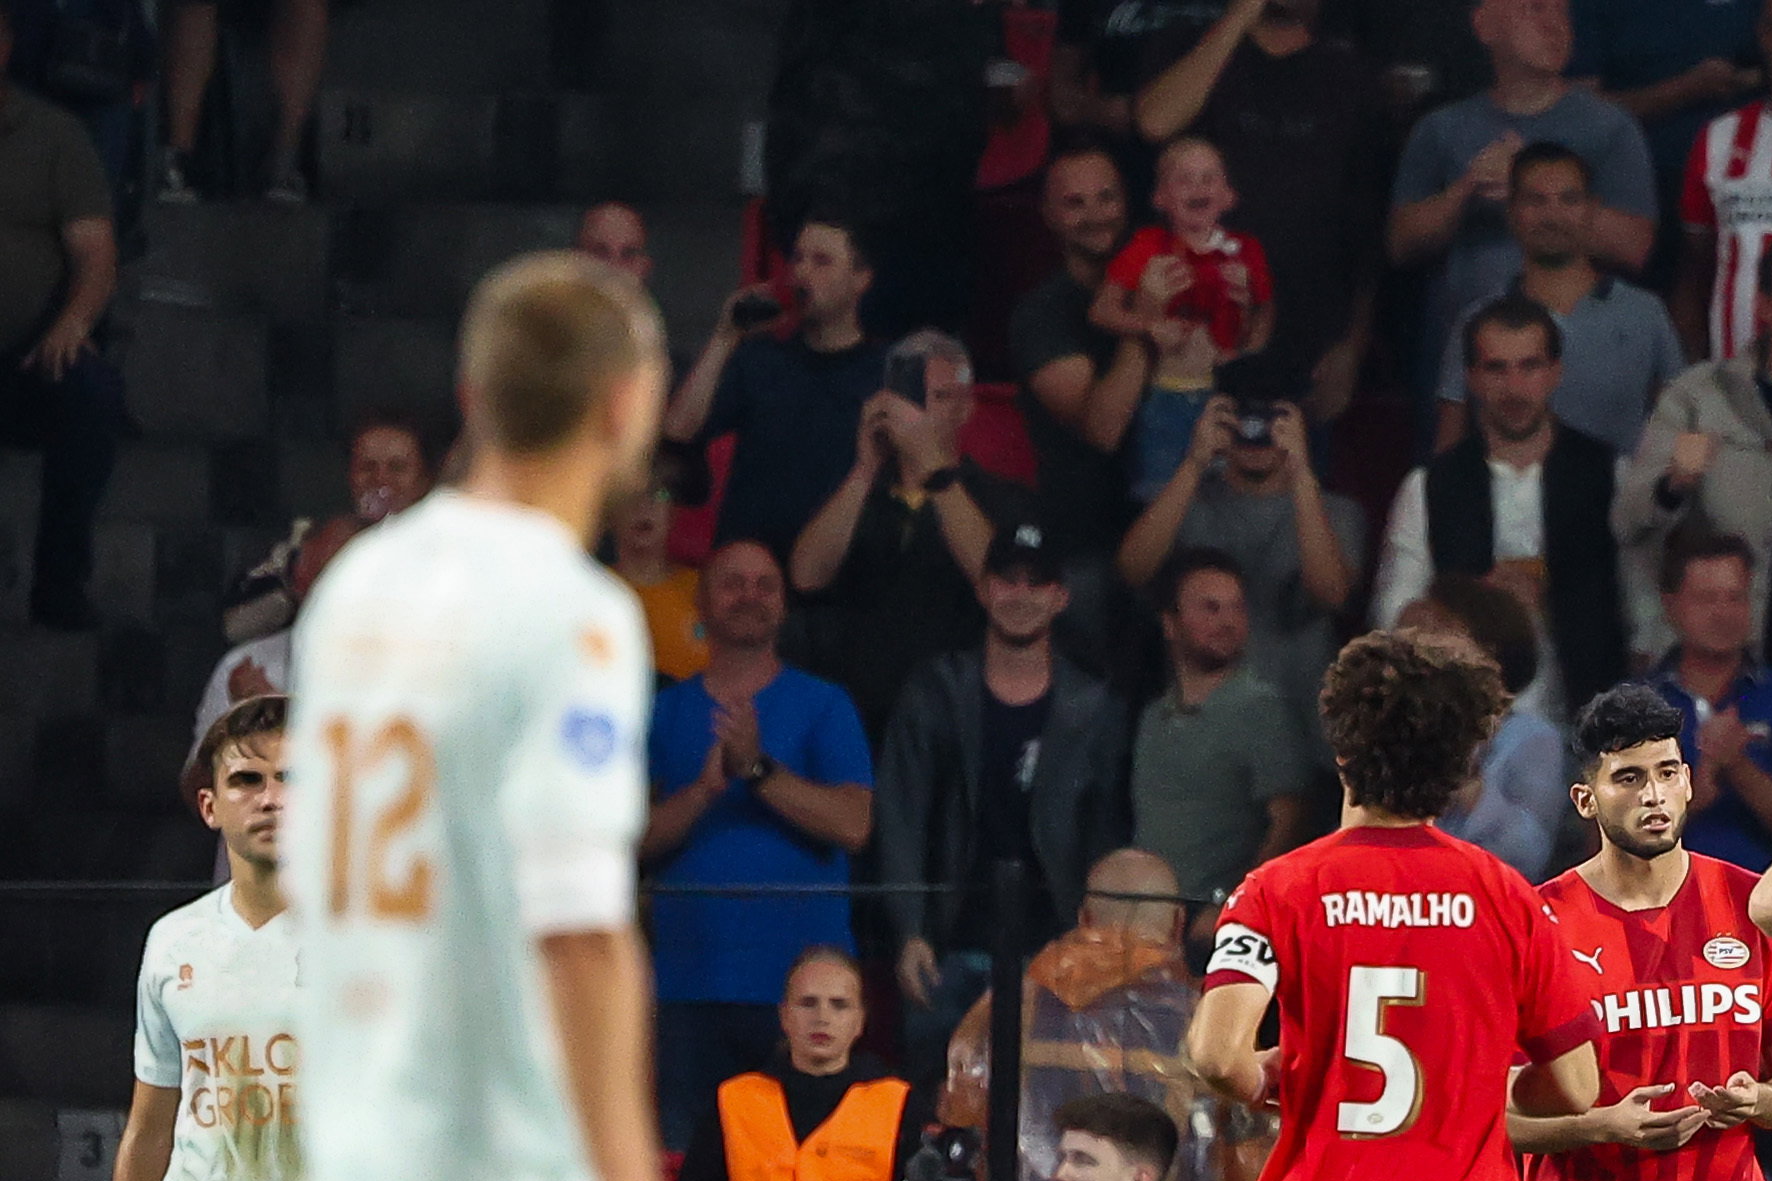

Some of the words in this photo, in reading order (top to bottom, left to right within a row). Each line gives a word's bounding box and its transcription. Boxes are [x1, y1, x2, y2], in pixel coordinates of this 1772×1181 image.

[321, 713, 440, 919] 12
[1322, 891, 1475, 929] RAMALHO
[210, 1033, 299, 1077] KLO
[1337, 965, 1427, 1139] 5
[190, 1083, 299, 1128] GROE
